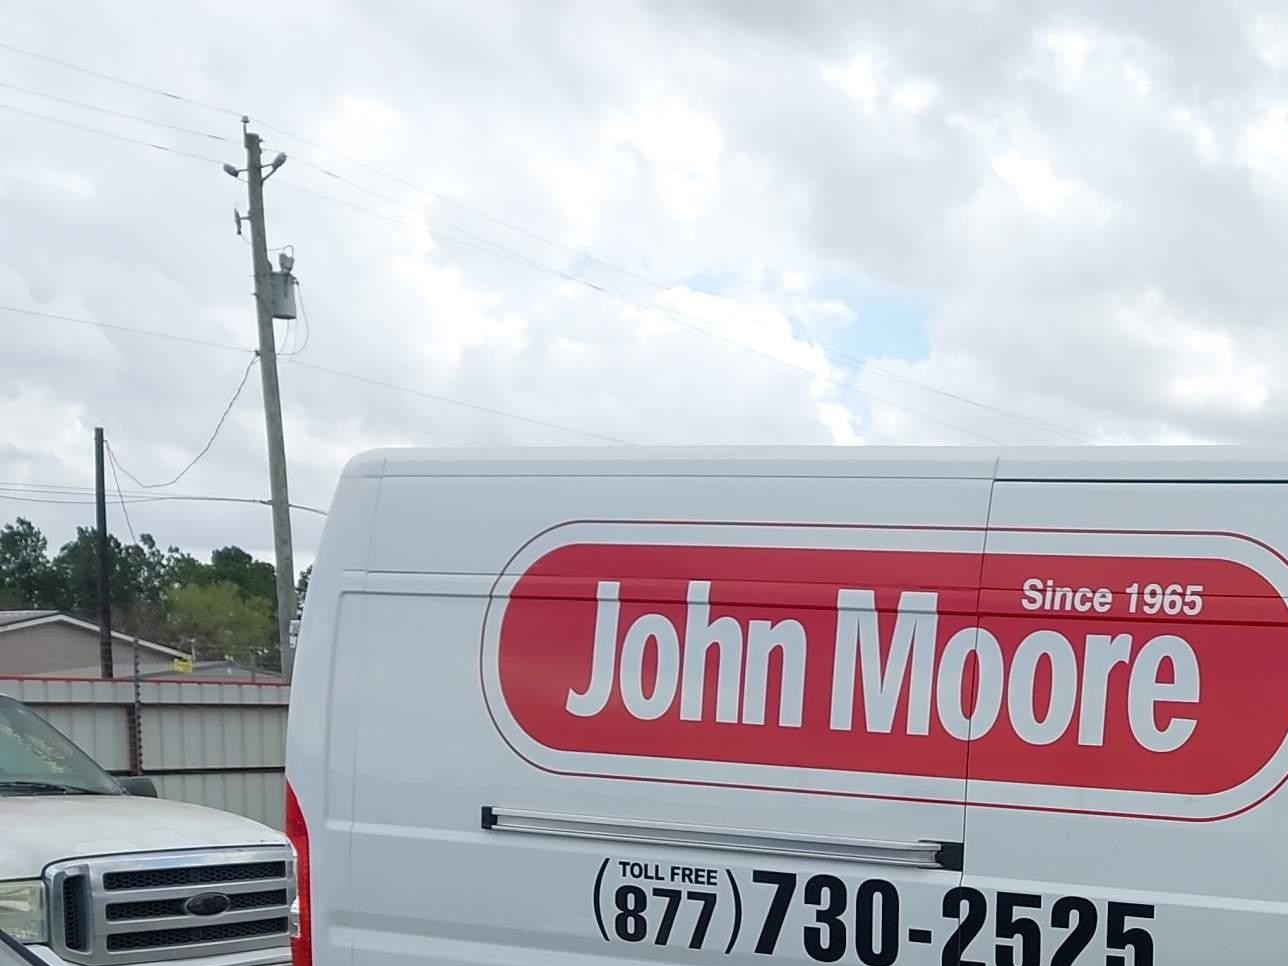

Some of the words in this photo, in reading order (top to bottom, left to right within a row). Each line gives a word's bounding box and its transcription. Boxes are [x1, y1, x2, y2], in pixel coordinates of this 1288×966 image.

[1021, 578, 1113, 613] Since
[1125, 583, 1203, 616] 1965
[565, 580, 807, 727] John
[830, 588, 1200, 752] Moore
[618, 861, 665, 881] TOLL
[670, 866, 718, 886] FREE
